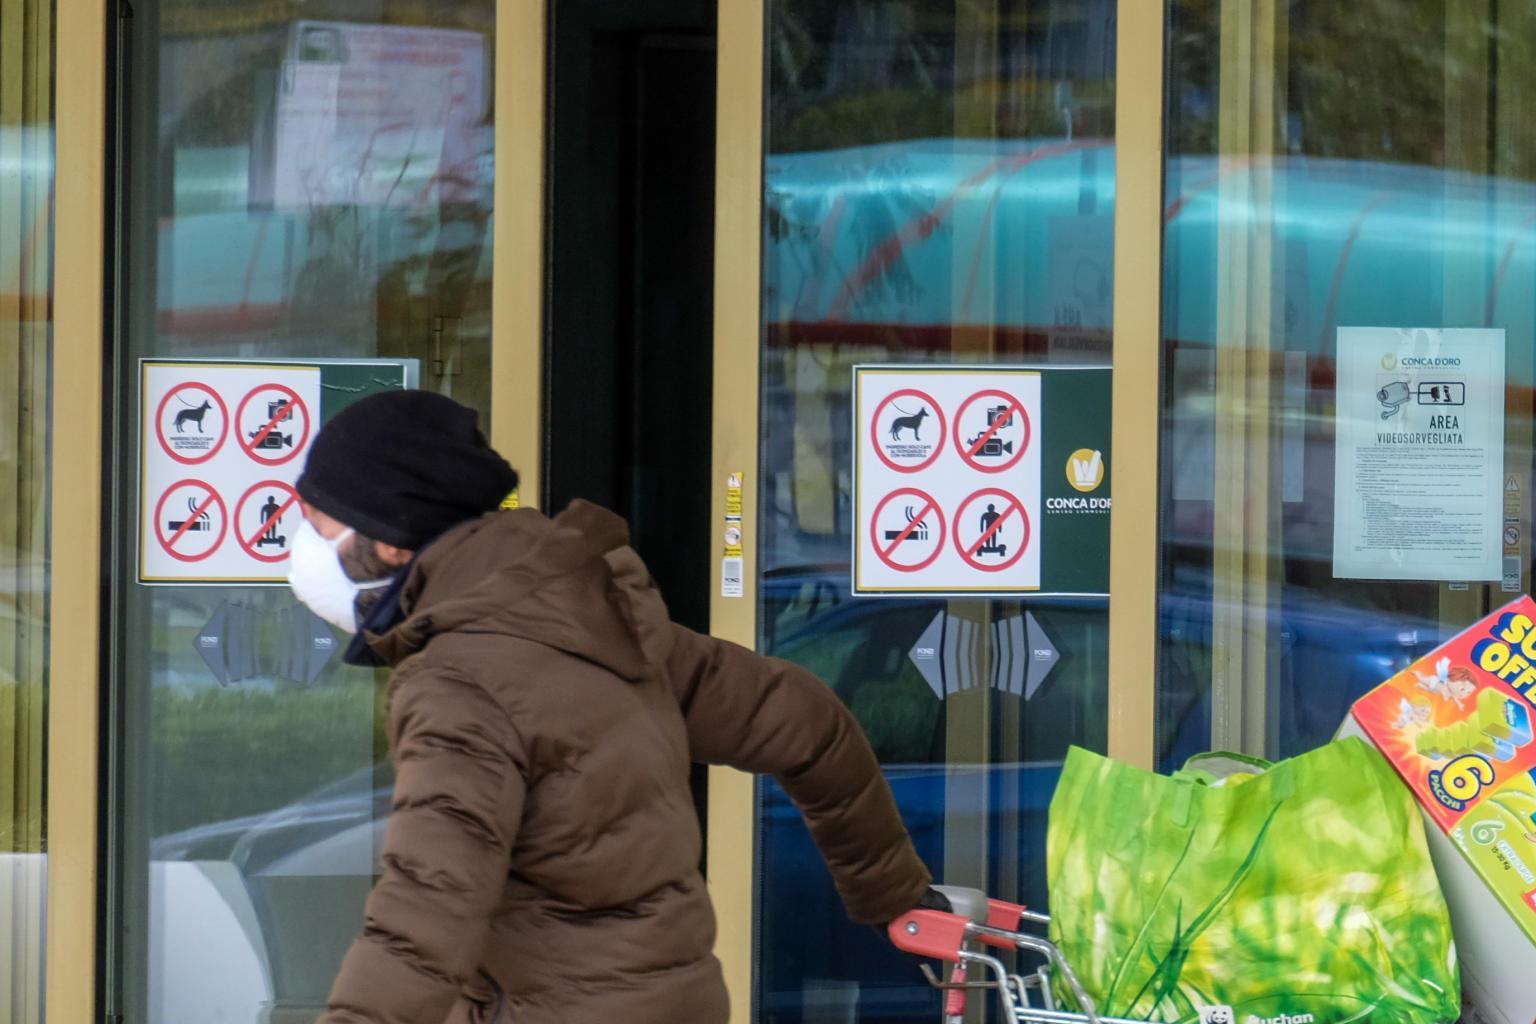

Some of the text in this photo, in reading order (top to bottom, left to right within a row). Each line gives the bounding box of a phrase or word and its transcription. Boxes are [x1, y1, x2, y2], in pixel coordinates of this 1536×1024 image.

[1401, 358, 1461, 366] CONCA D'ORO
[1429, 415, 1459, 430] AREA
[1377, 432, 1463, 445] VIDEOSORVEGLIATA
[1046, 498, 1089, 509] CONCA
[1441, 754, 1496, 801] 6
[1430, 774, 1461, 810] PACCHI
[1471, 820, 1505, 846] 6
